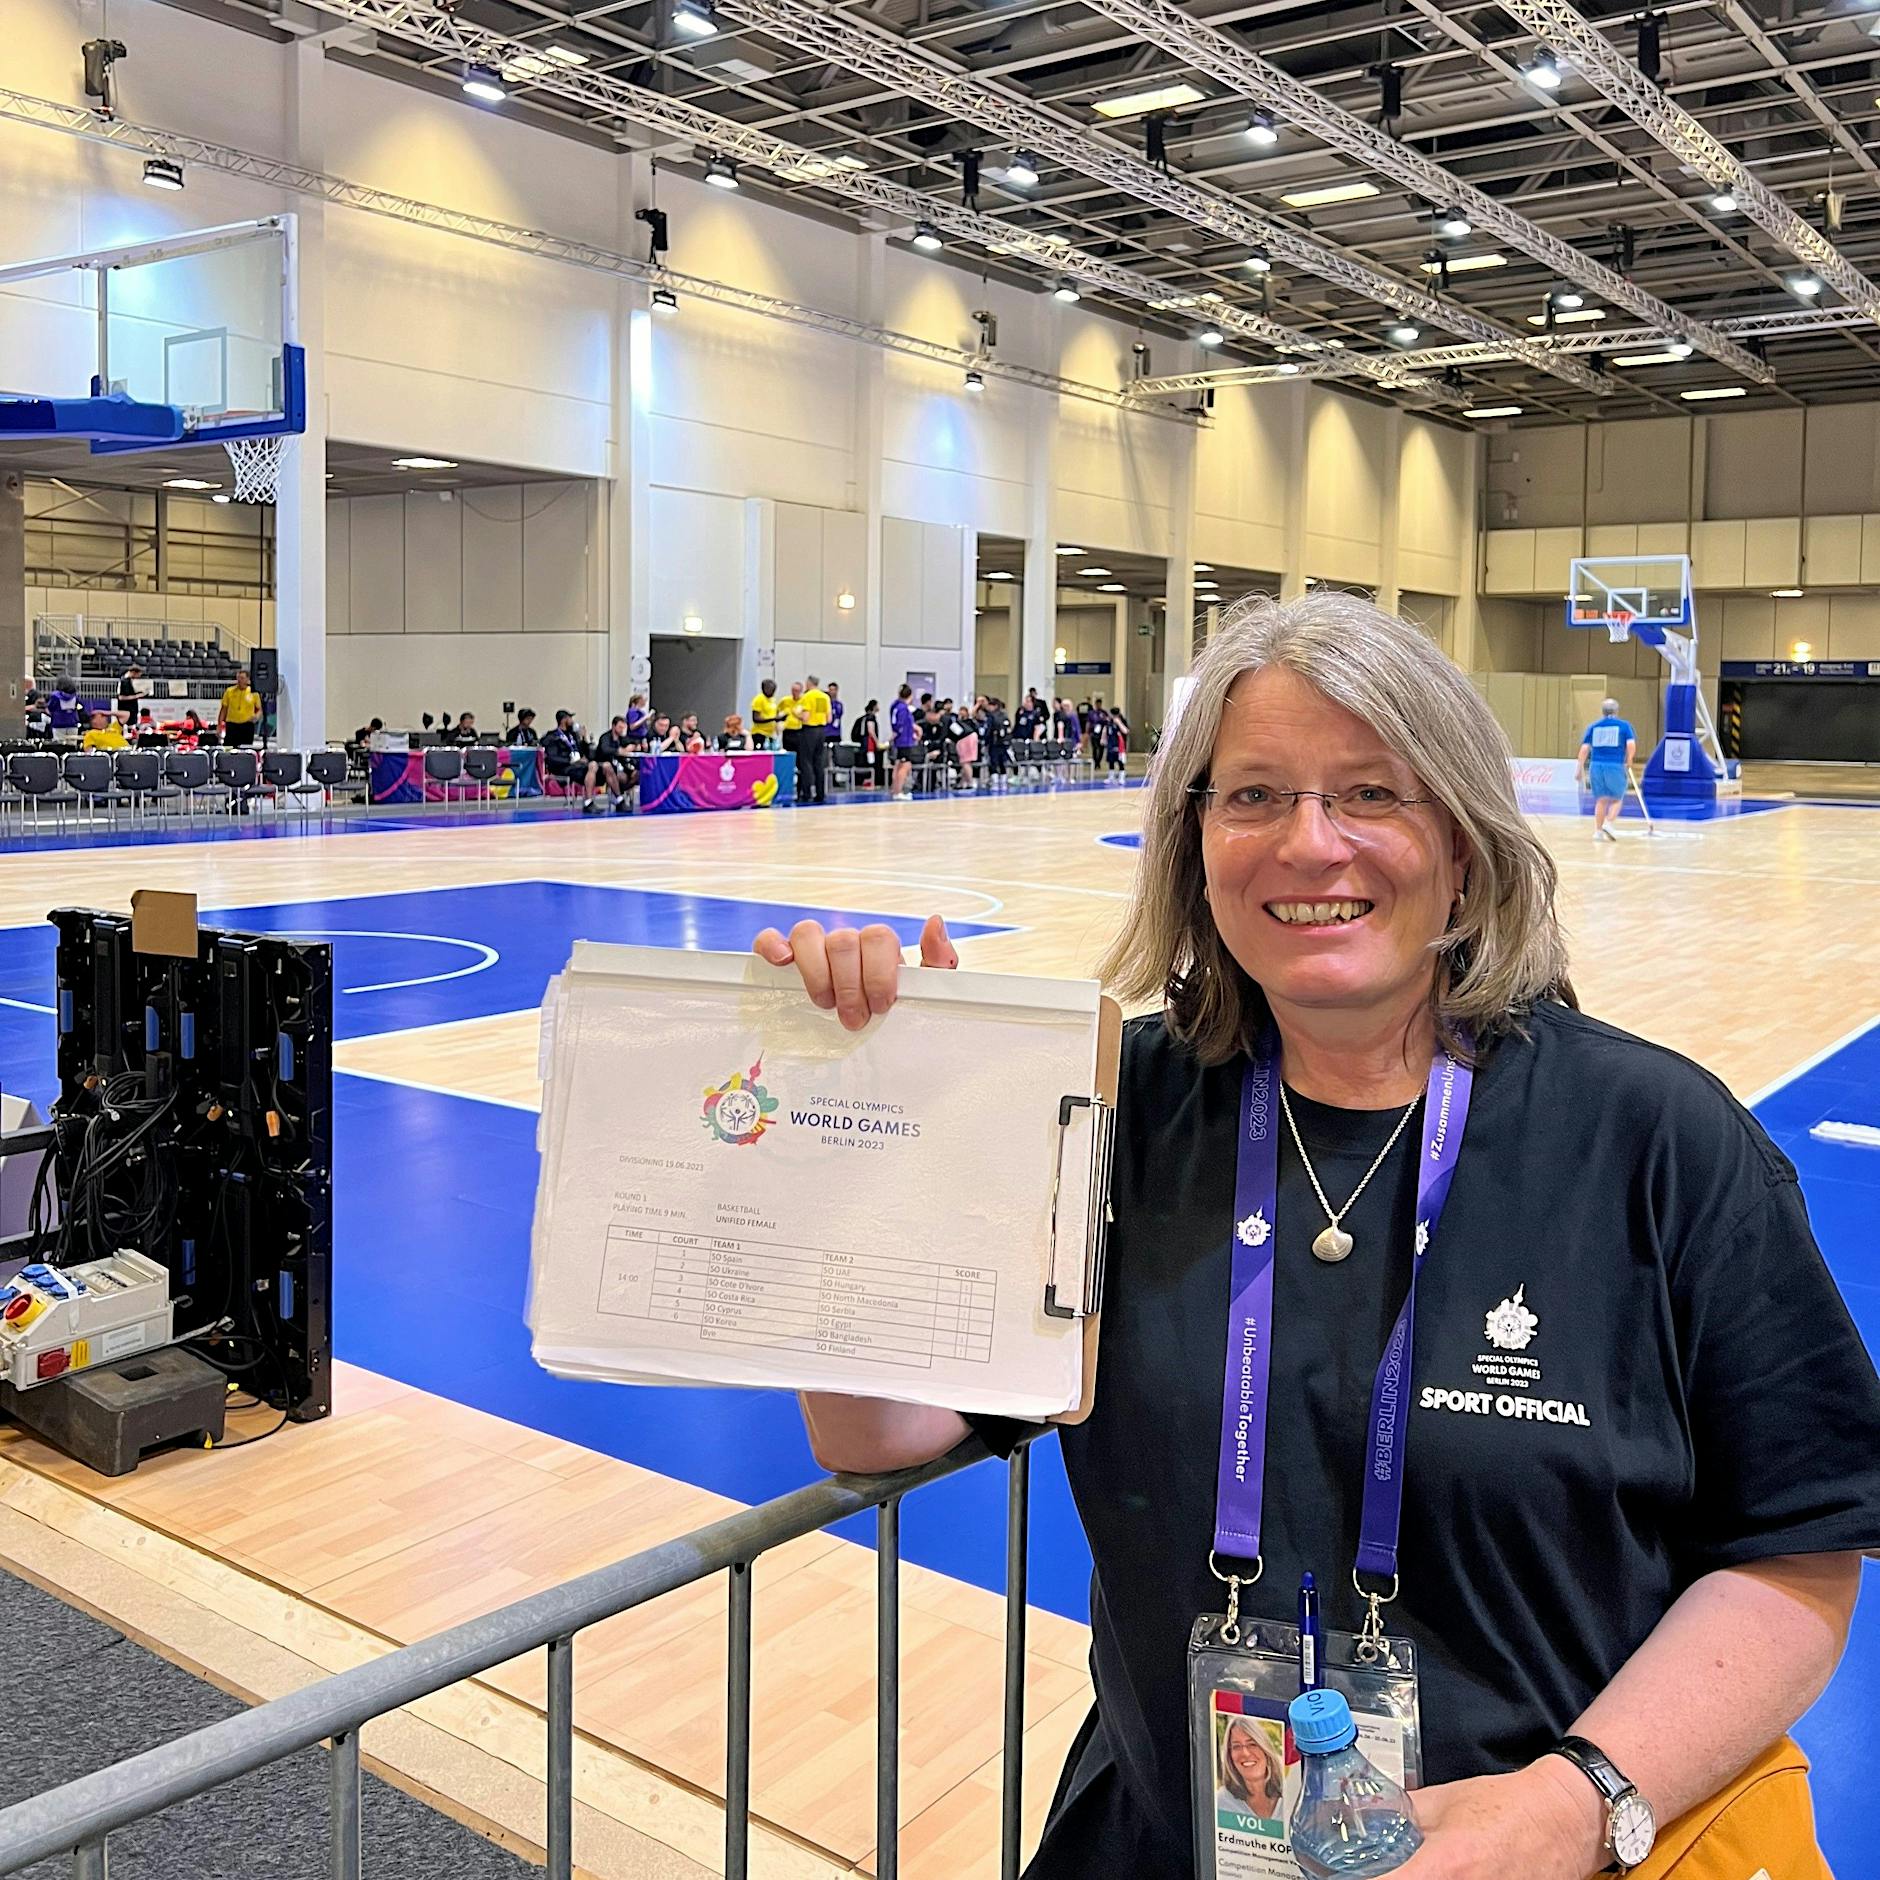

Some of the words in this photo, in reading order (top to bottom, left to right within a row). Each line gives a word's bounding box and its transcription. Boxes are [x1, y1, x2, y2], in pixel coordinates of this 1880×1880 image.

[810, 1096, 850, 1109] SPECIAL
[852, 1100, 905, 1114] OLYMPICS
[790, 1111, 853, 1130] WORLD
[858, 1118, 921, 1138] GAMES
[821, 1136, 855, 1148] BERLIN
[858, 1139, 885, 1150] 2023
[619, 1155, 664, 1167] DIVISIONING
[665, 1160, 704, 1172] 19.06.2023
[614, 1191, 641, 1201] ROUND
[612, 1203, 643, 1214] PLAYING
[644, 1207, 664, 1217] TIME
[717, 1203, 761, 1215] BASKETBALL
[715, 1215, 746, 1226] UNIFIED
[747, 1219, 777, 1230] FEMALE
[625, 1230, 644, 1239] TIME
[672, 1235, 699, 1246] COURT
[713, 1240, 735, 1250] TEAM
[711, 1254, 722, 1262] SO
[723, 1255, 743, 1265] Spain
[825, 1253, 847, 1264] TEAM
[710, 1265, 720, 1273] SO
[722, 1266, 750, 1277] Ukraine
[823, 1266, 834, 1275] SO
[955, 1269, 981, 1279] SCORE
[708, 1278, 719, 1286] SO
[822, 1278, 833, 1288] SO
[834, 1280, 866, 1292] Hungary
[707, 1290, 718, 1298] SO
[719, 1292, 739, 1302] Costa
[820, 1291, 832, 1300] SO
[833, 1293, 856, 1303] North
[857, 1296, 899, 1309] Macedonia
[705, 1303, 716, 1312] SO
[717, 1305, 742, 1316] Cyprus
[820, 1304, 831, 1313] SO
[832, 1306, 856, 1316] Serbia
[715, 1317, 737, 1327] Korea
[818, 1317, 830, 1326] SO
[831, 1319, 852, 1330] Egypt
[817, 1330, 828, 1339] SO
[829, 1331, 872, 1344] Bangladesh
[816, 1343, 827, 1351] SO
[828, 1344, 856, 1355] Finland
[1477, 1354, 1504, 1364] SPECIAL
[1504, 1356, 1539, 1367] OLYMPICS
[1472, 1363, 1508, 1376] WORLD
[1508, 1366, 1541, 1380] GAMES
[1486, 1376, 1510, 1386] BERLIN
[1510, 1378, 1529, 1388] 2023
[1234, 1317, 1257, 1483] #UnbeatableTogether
[1419, 1386, 1494, 1415] SPORT
[1495, 1395, 1591, 1427] OFFICIAL
[1236, 1814, 1266, 1832] VOL
[1218, 1832, 1267, 1851] Erdmuthe
[1218, 1858, 1267, 1876] Competition
